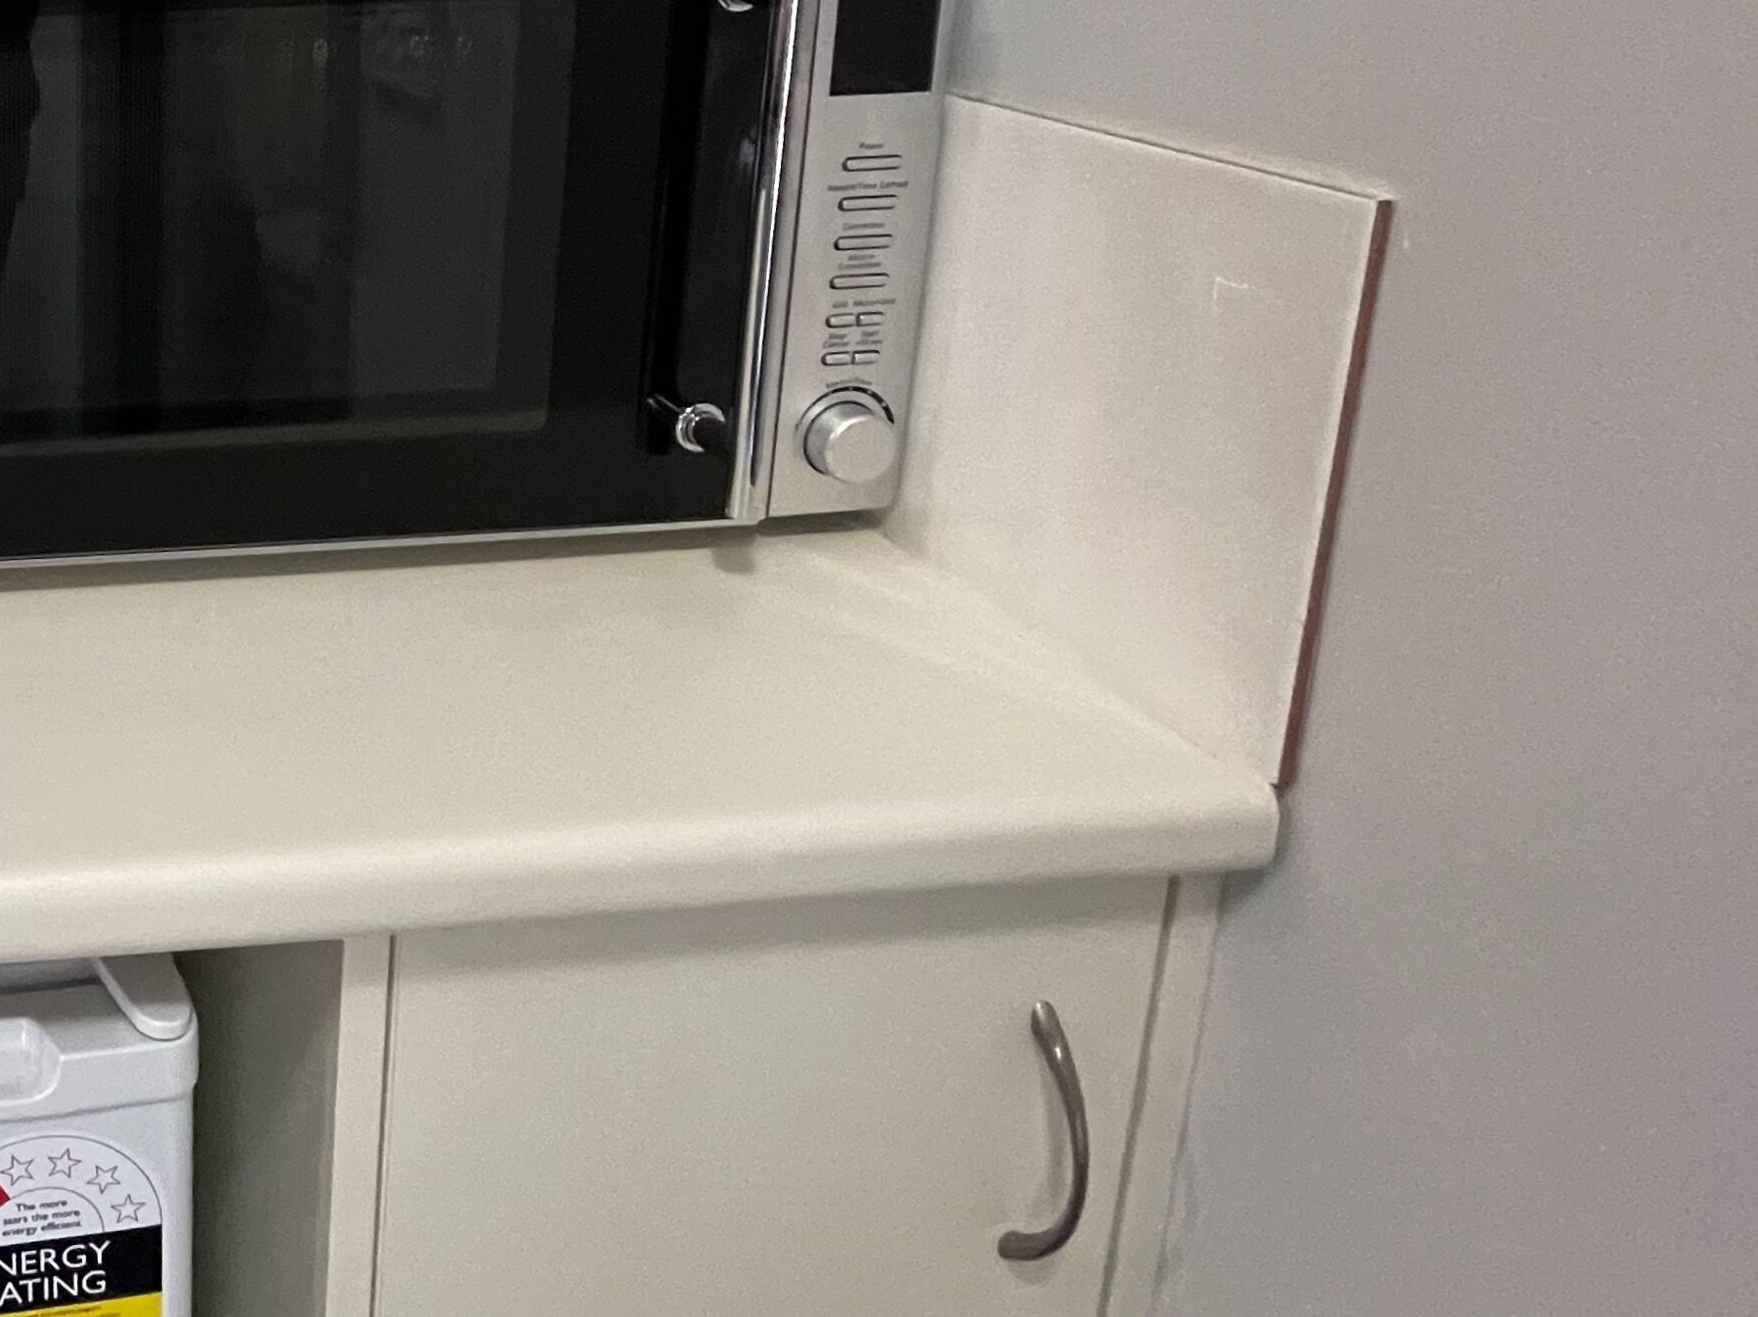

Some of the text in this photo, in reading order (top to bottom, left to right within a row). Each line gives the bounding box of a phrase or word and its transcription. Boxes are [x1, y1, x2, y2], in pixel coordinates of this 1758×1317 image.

[16, 1200, 67, 1212] The more
[31, 1213, 49, 1222] the
[52, 1210, 81, 1219] more
[2, 1226, 38, 1237] energy
